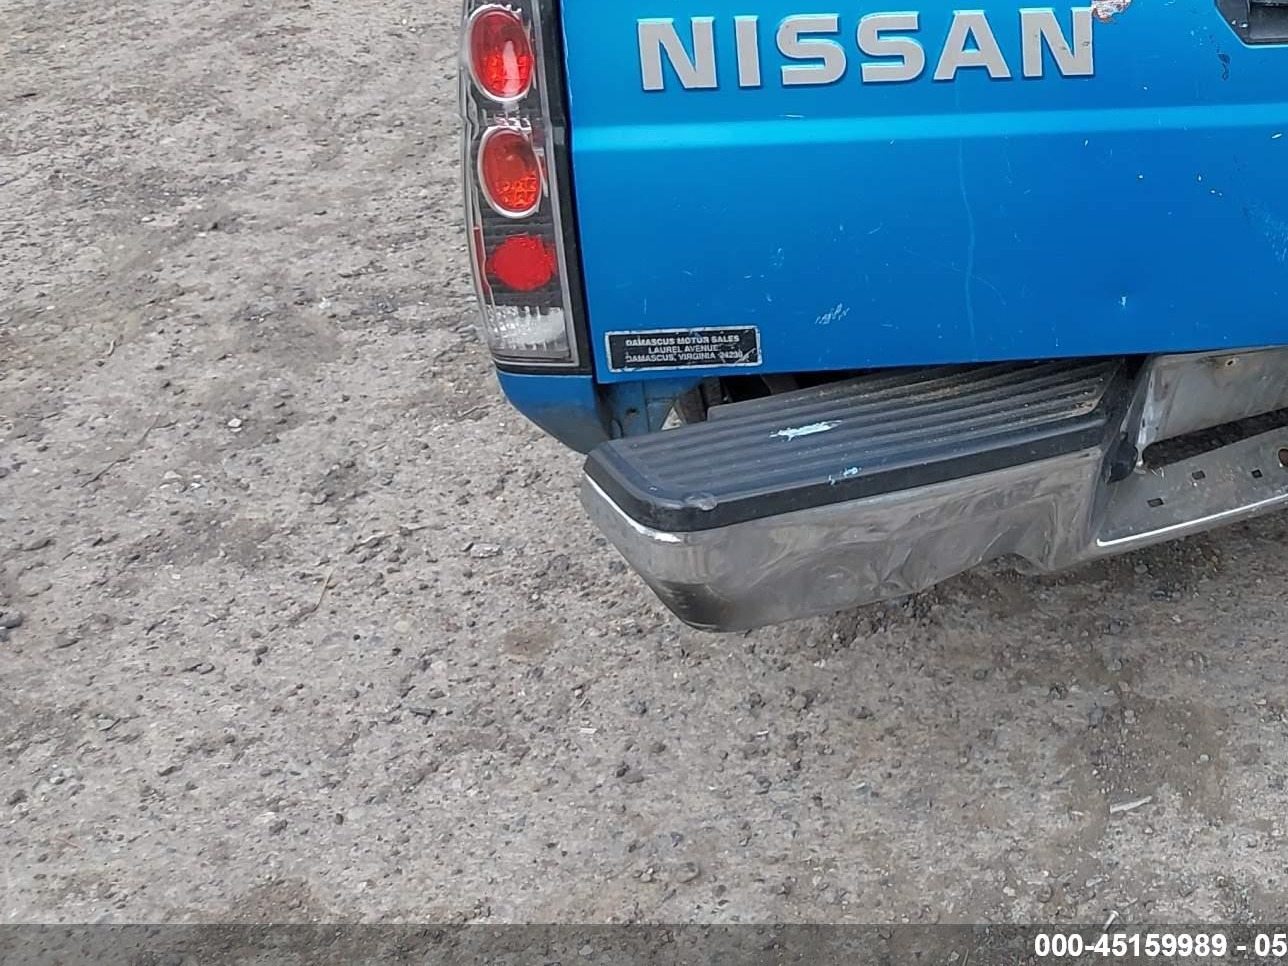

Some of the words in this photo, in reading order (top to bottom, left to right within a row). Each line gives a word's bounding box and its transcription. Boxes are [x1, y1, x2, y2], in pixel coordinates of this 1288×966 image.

[636, 6, 1096, 92] NISSAN
[625, 337, 675, 347] DAMASCUS
[711, 335, 740, 343] SALES
[648, 345, 682, 354] LAUREL
[684, 344, 719, 353] AVENUE
[679, 352, 716, 361] VIRGINIA
